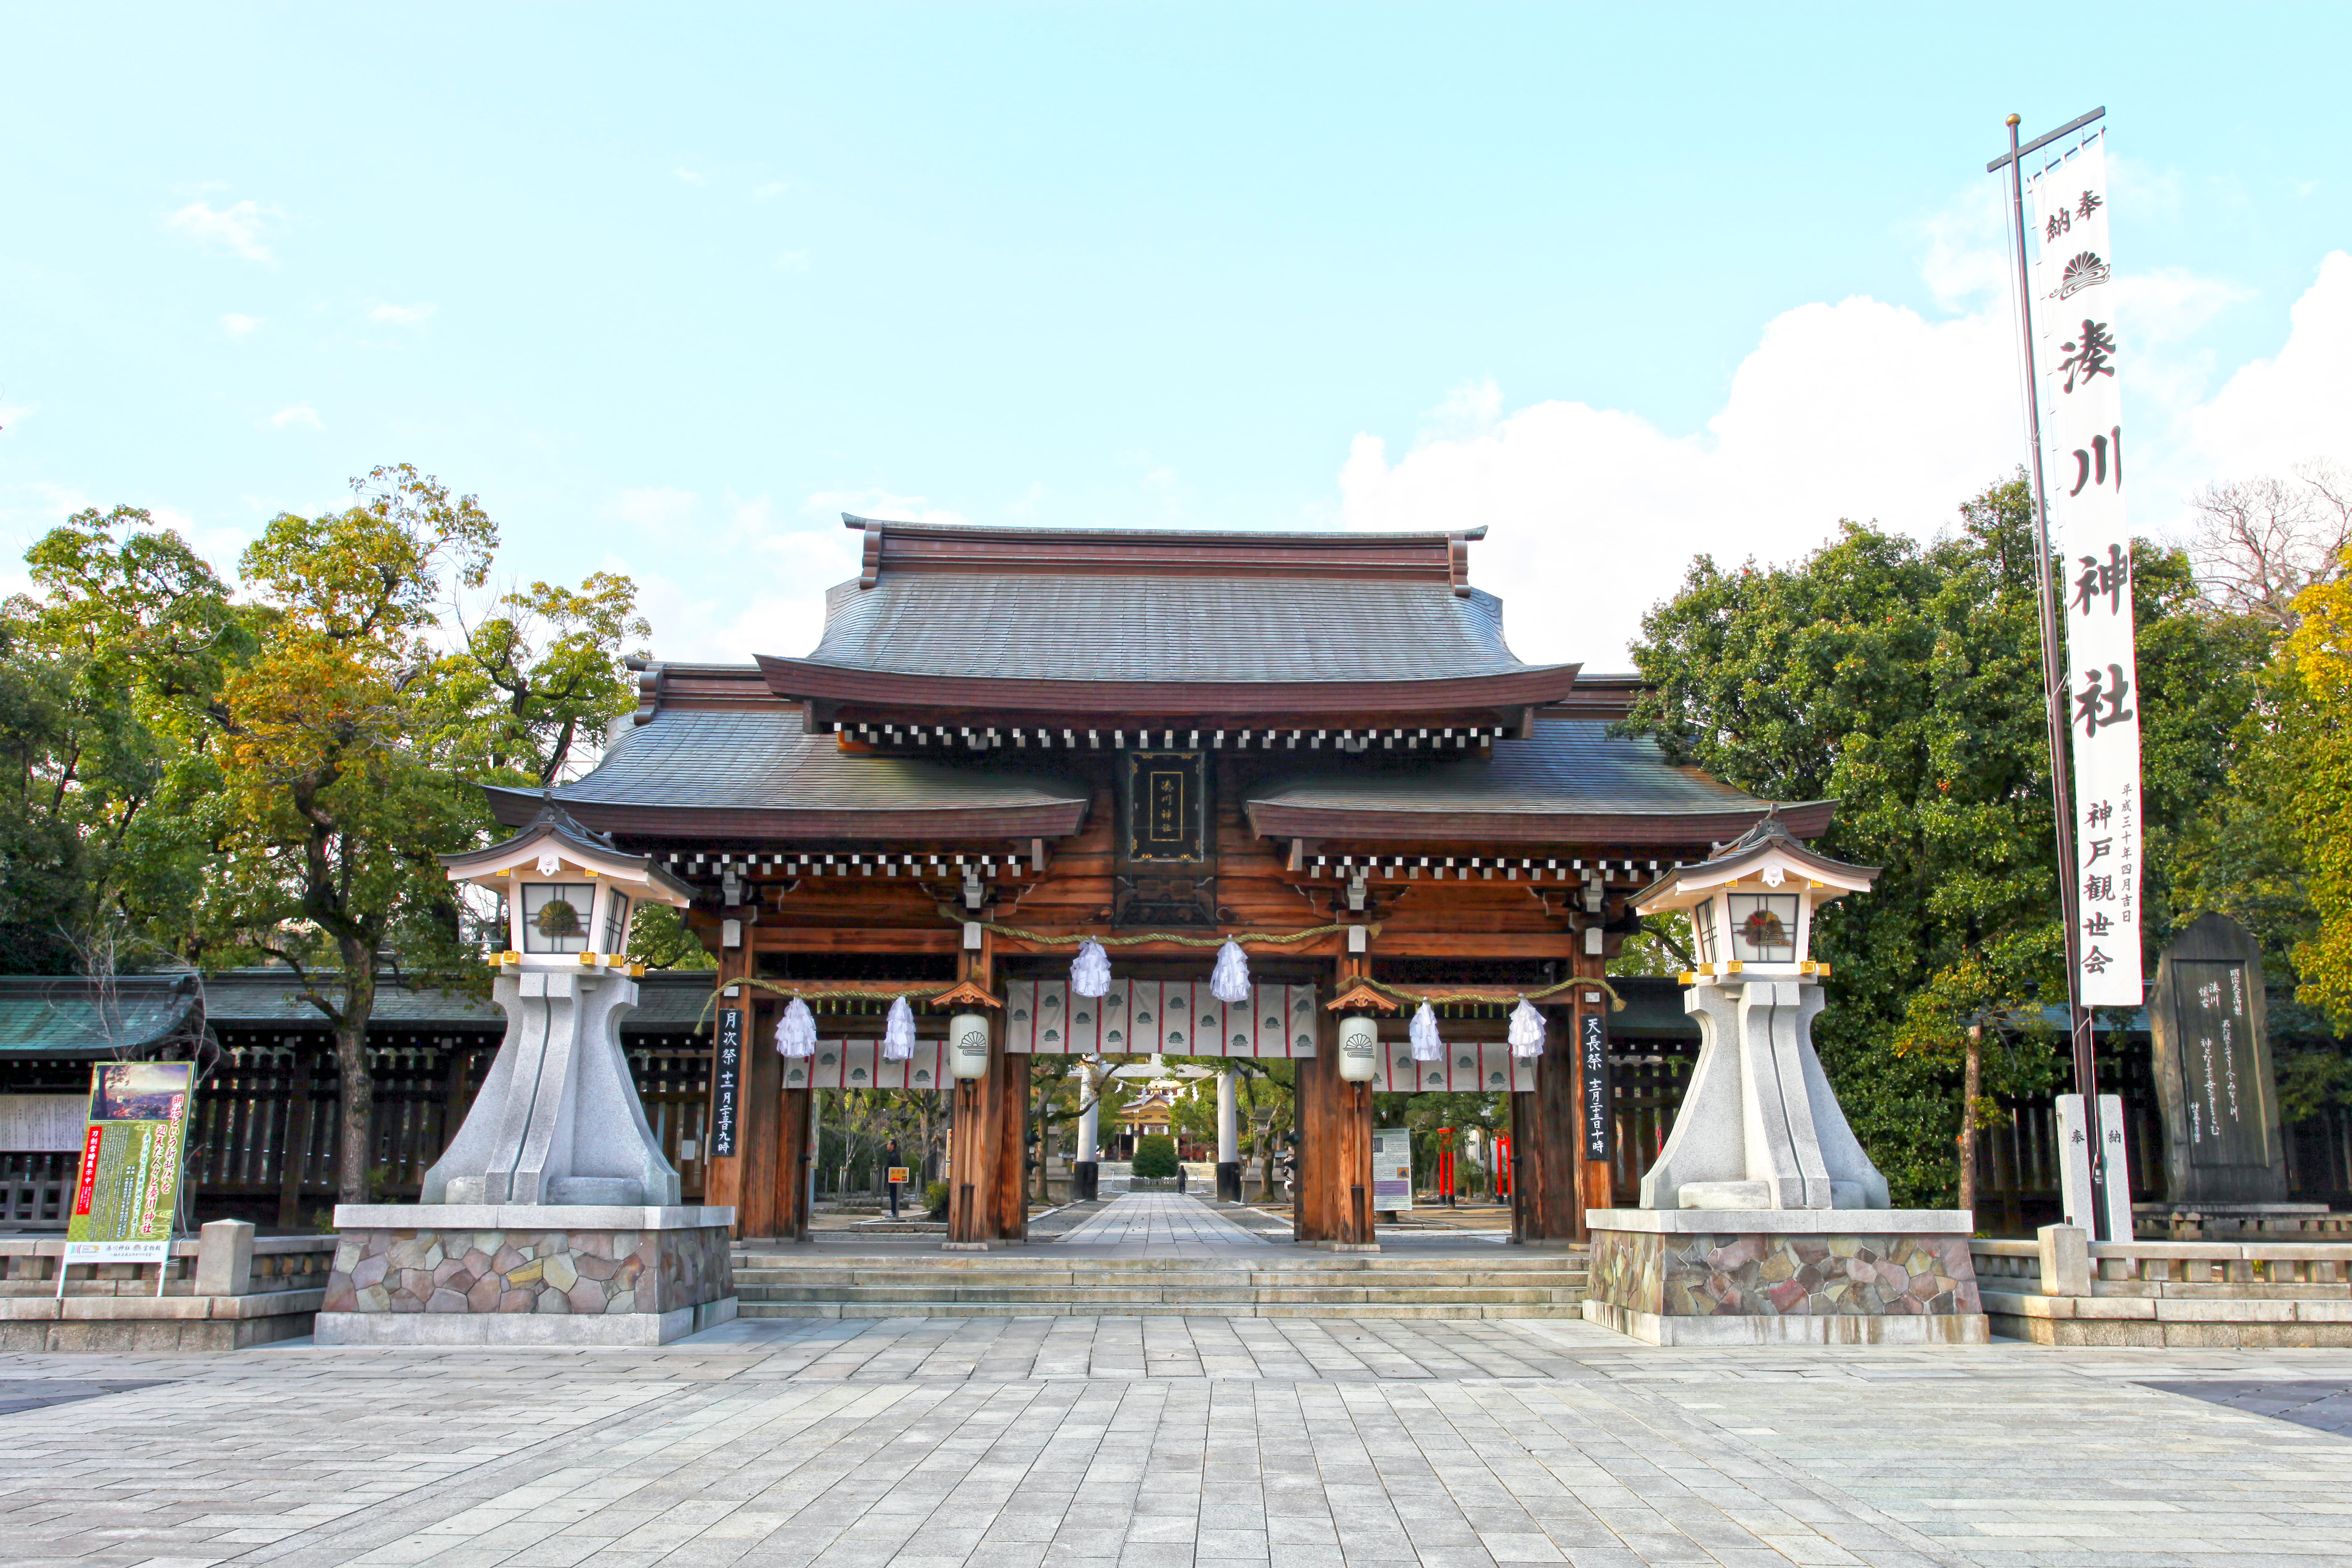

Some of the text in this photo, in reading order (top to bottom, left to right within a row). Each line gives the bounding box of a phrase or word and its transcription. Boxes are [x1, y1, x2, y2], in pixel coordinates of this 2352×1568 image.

[2058, 319, 2133, 738] 湊川神社
[1162, 780, 1173, 832] 湊川神社
[2121, 783, 2132, 922] 平成三十年四月吉日
[2081, 800, 2116, 974] 神戸観世会
[719, 1013, 736, 1153] 月次祭 十二月二十五日九時
[1586, 1019, 1603, 1153] 天長祭 十二月二十三日十時
[2071, 1129, 2086, 1144] 奉
[2109, 1130, 2121, 1143] 納
[85, 1130, 98, 1184] 刀剣常時展示中
[142, 1126, 167, 1234] 迎えた人々と湊川神社
[162, 1095, 184, 1193] 明治という新時代を
